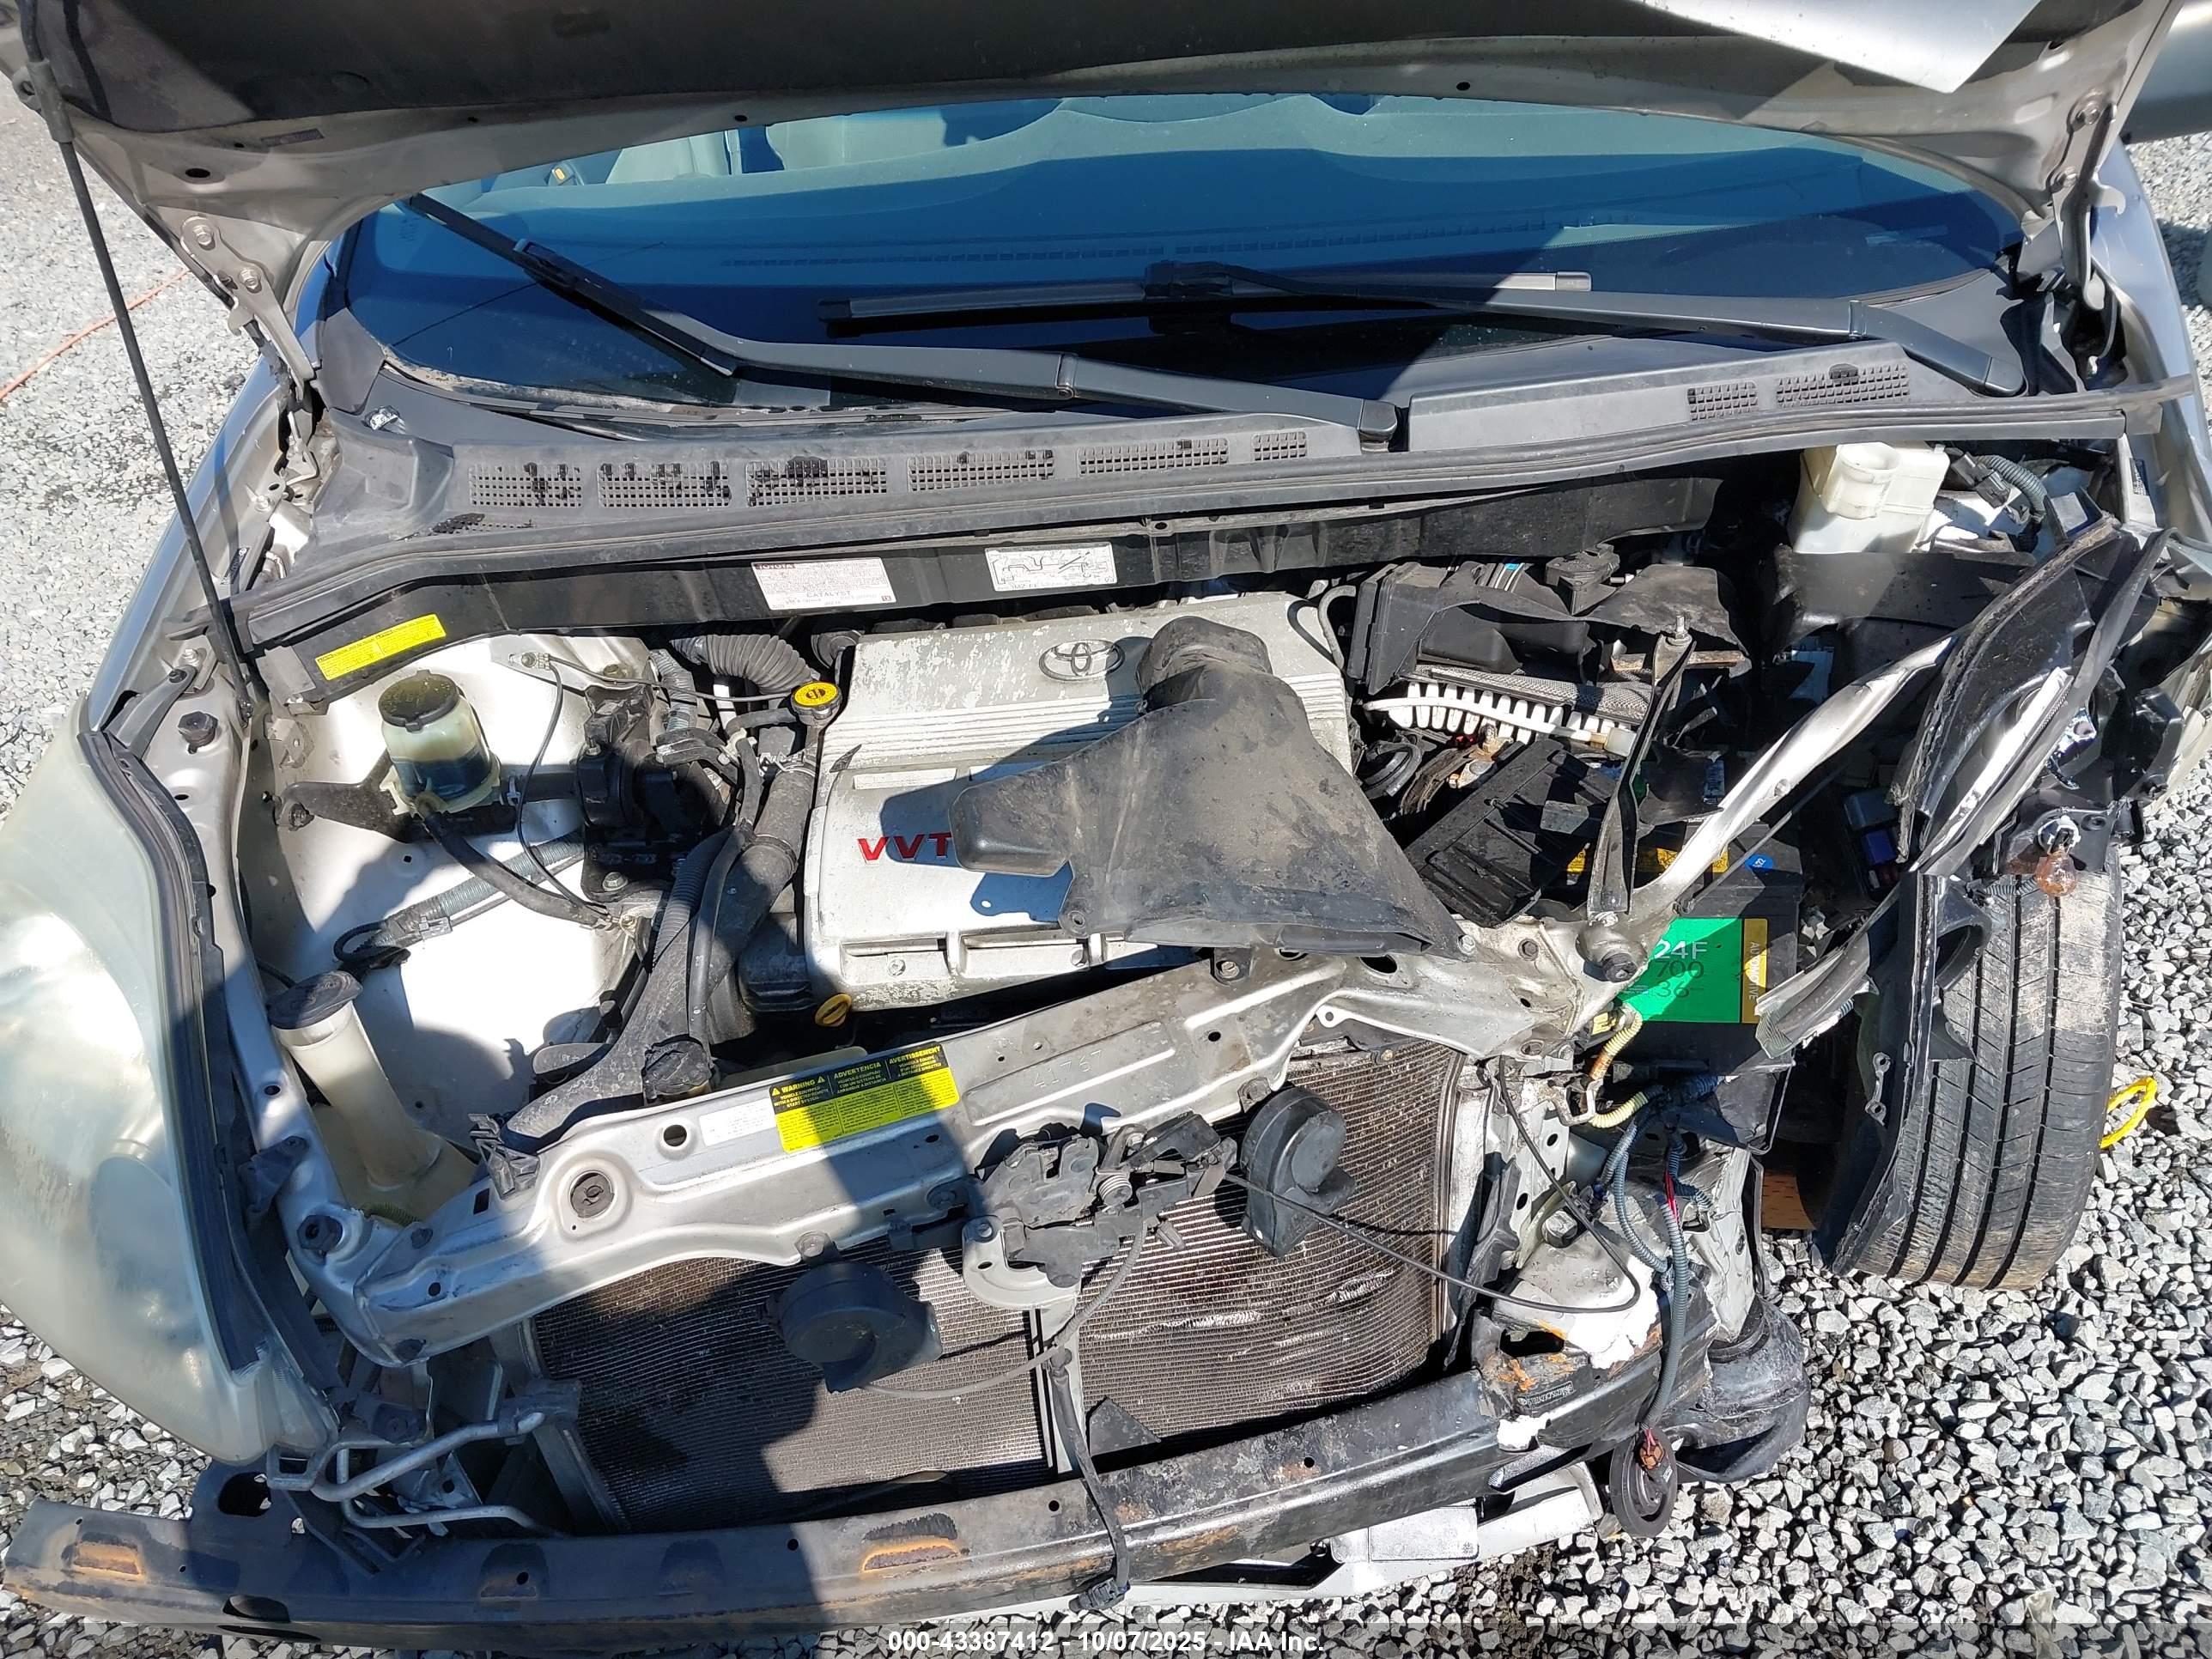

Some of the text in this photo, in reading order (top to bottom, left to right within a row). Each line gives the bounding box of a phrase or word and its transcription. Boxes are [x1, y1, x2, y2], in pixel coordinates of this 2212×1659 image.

[1654, 939, 1708, 960] 24F
[1655, 959, 1705, 979] 700
[1747, 940, 1760, 1000] AUTOMOTIVE
[889, 1047, 940, 1065] AVERTISSEMENT
[834, 1062, 881, 1079] ADVERTENCIA
[781, 1079, 815, 1093] WARNING
